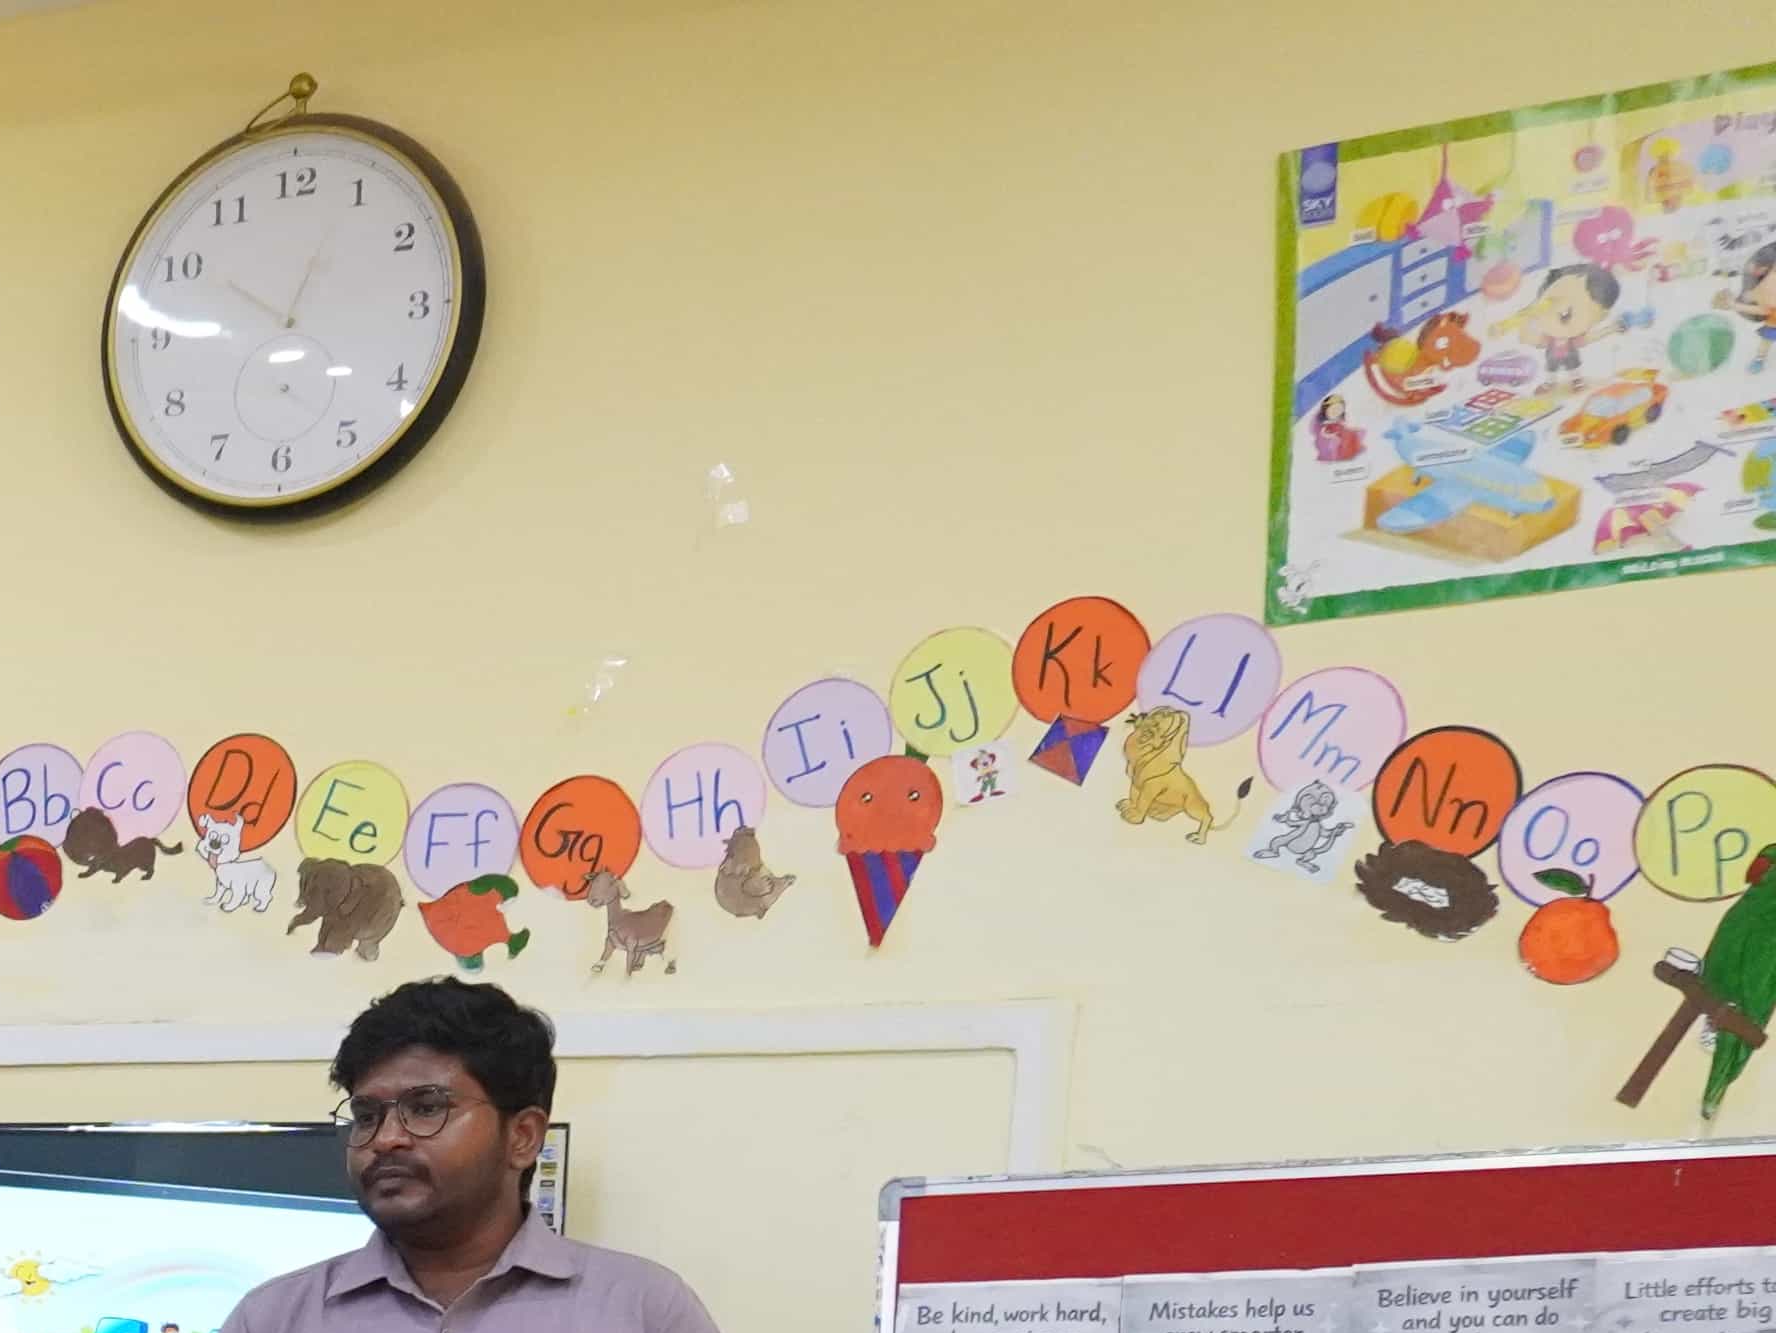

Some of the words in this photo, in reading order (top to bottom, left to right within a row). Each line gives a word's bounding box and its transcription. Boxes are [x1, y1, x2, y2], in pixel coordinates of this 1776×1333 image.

[275, 167, 318, 200] 12
[352, 179, 367, 207] 1
[211, 196, 249, 227] 11
[1302, 197, 1333, 211] SKY
[393, 222, 416, 252] 2
[164, 252, 203, 282] 10
[408, 291, 430, 320] 3
[386, 363, 408, 392] 4
[165, 389, 186, 416] 8
[209, 434, 230, 461] 7
[336, 420, 358, 448] 5
[271, 445, 292, 472] 6
[1, 768, 72, 836] Bb
[96, 761, 155, 812] Cc
[208, 749, 282, 828] Dd
[312, 777, 378, 855] Ee
[424, 810, 499, 869] Ff
[534, 802, 604, 893] Gg
[666, 768, 744, 840] Hh
[777, 713, 856, 784] Ii
[905, 663, 980, 743] Jj
[1038, 625, 1115, 709] Kk
[1162, 632, 1252, 717] Ll
[1269, 690, 1362, 784] Mm
[1389, 757, 1489, 839] Nn
[1523, 804, 1600, 867] Oo
[1667, 790, 1750, 897] Pp
[1377, 1285, 1452, 1309] Believe
[1460, 1285, 1479, 1303] in
[1488, 1277, 1579, 1309] yourself
[1625, 1278, 1677, 1300] Little
[1685, 1276, 1755, 1296] efforts
[917, 1306, 943, 1325] Be
[951, 1301, 999, 1326] kind,
[1004, 1304, 1048, 1323] work
[1056, 1301, 1107, 1325] hard,
[1149, 1300, 1238, 1321] Mistakes
[1245, 1297, 1286, 1324] help
[1293, 1303, 1314, 1317] us
[1402, 1310, 1441, 1331] and
[1449, 1314, 1485, 1333] you
[1492, 1313, 1528, 1328] can
[1535, 1306, 1559, 1326] do
[1659, 1304, 1728, 1322] create
[1736, 1299, 1773, 1324] big
